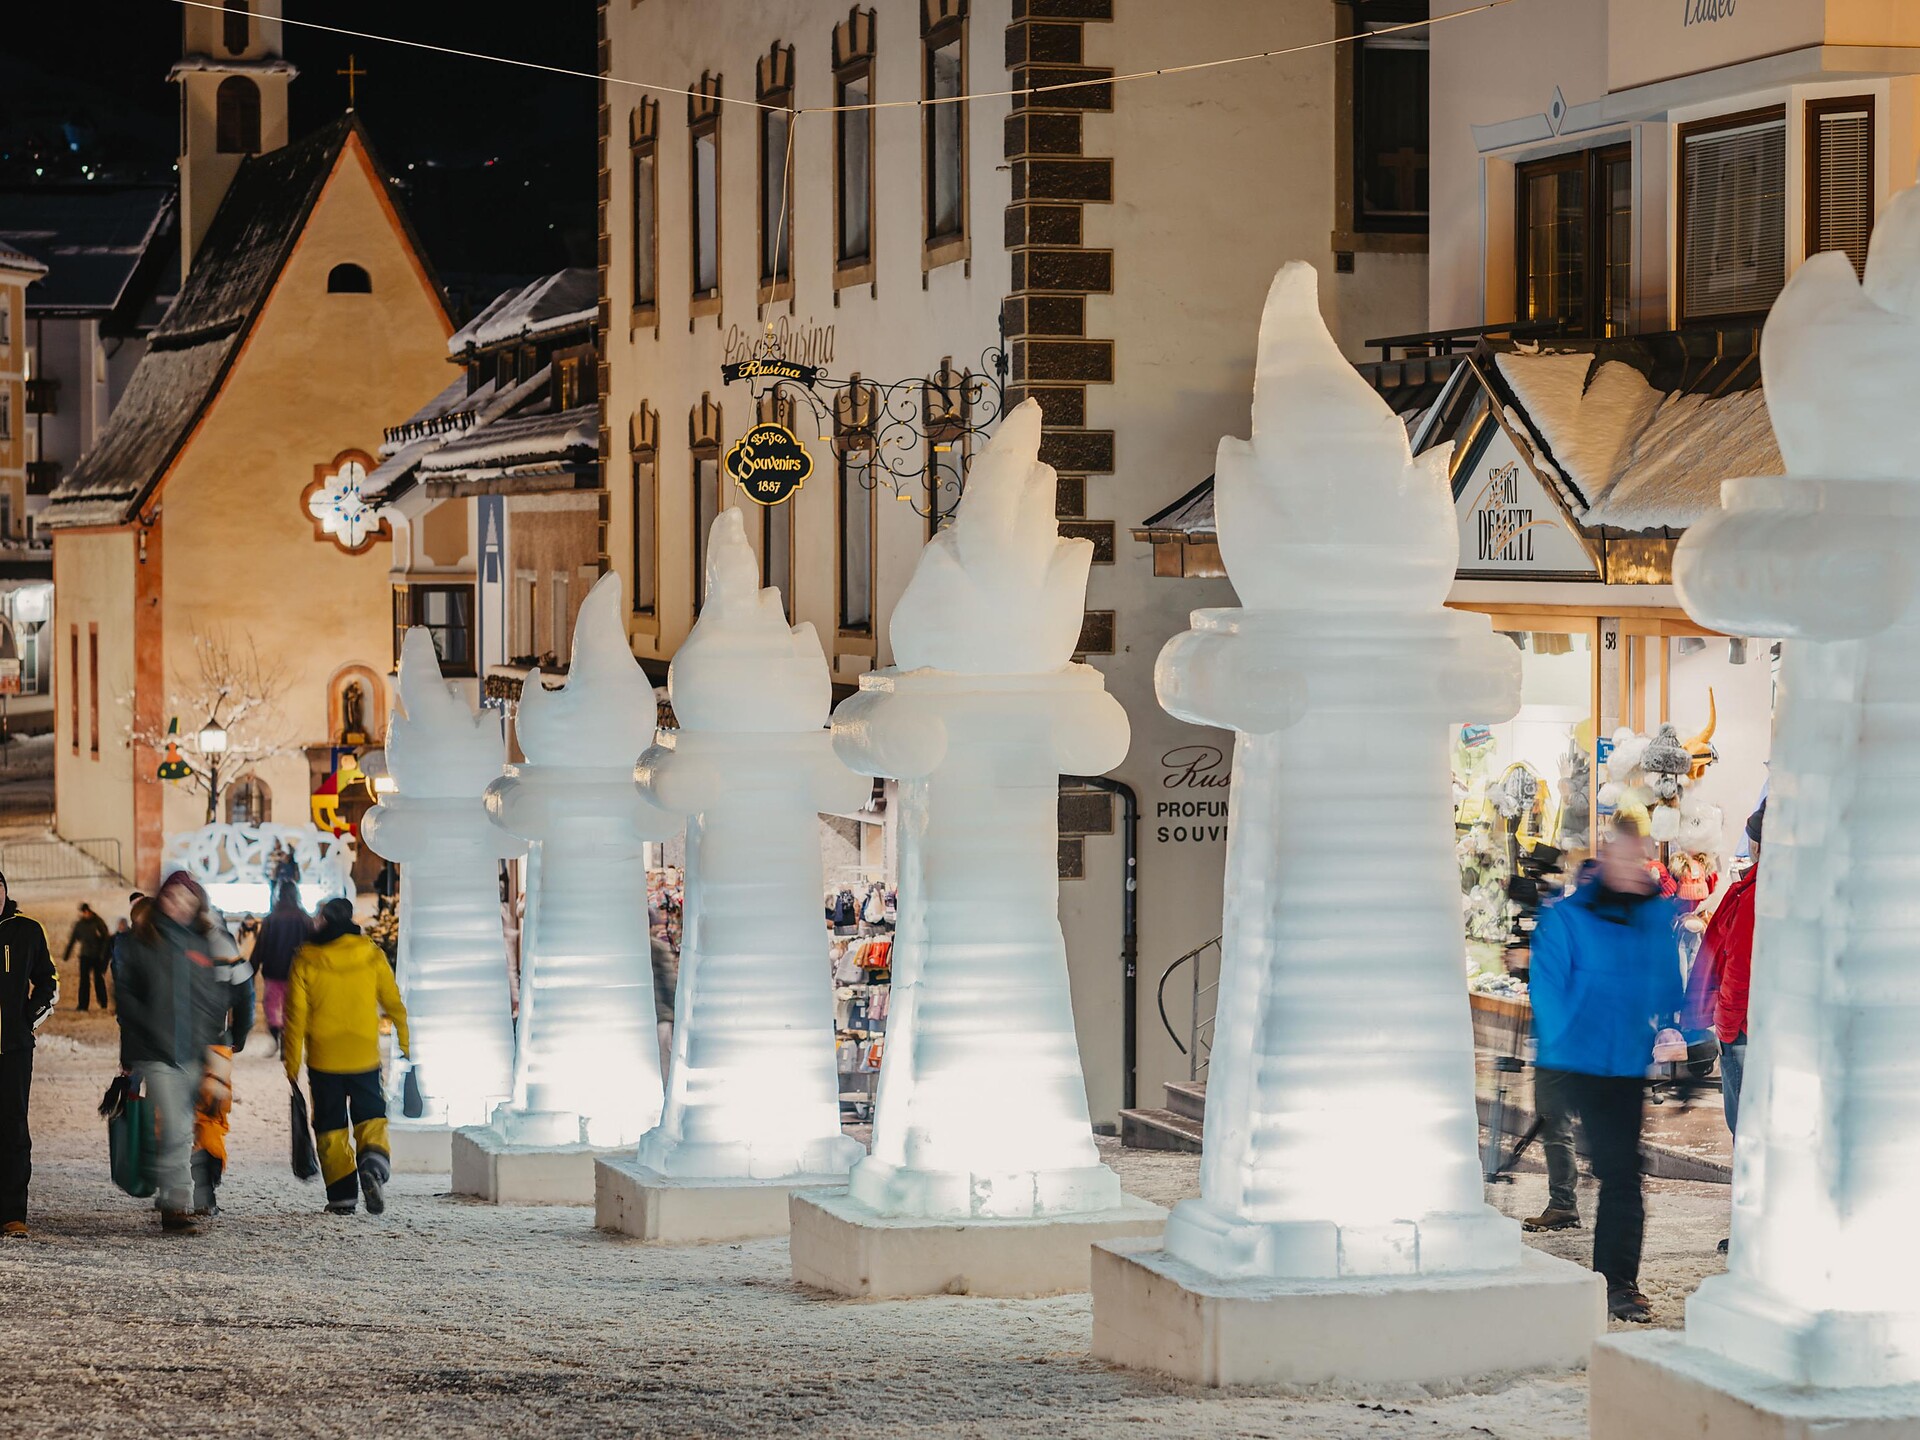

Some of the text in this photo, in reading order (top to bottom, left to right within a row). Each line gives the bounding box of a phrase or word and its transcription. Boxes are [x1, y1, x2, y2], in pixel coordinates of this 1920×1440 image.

[738, 360, 801, 379] Rusina
[750, 431, 787, 446] Bazar
[738, 445, 801, 480] Souvenirs
[757, 480, 781, 494] 1887
[1488, 467, 1519, 504] SPORT
[1478, 509, 1534, 561] DEMETZ
[1605, 631, 1616, 650] 58
[1157, 826, 1228, 842] SOUV
